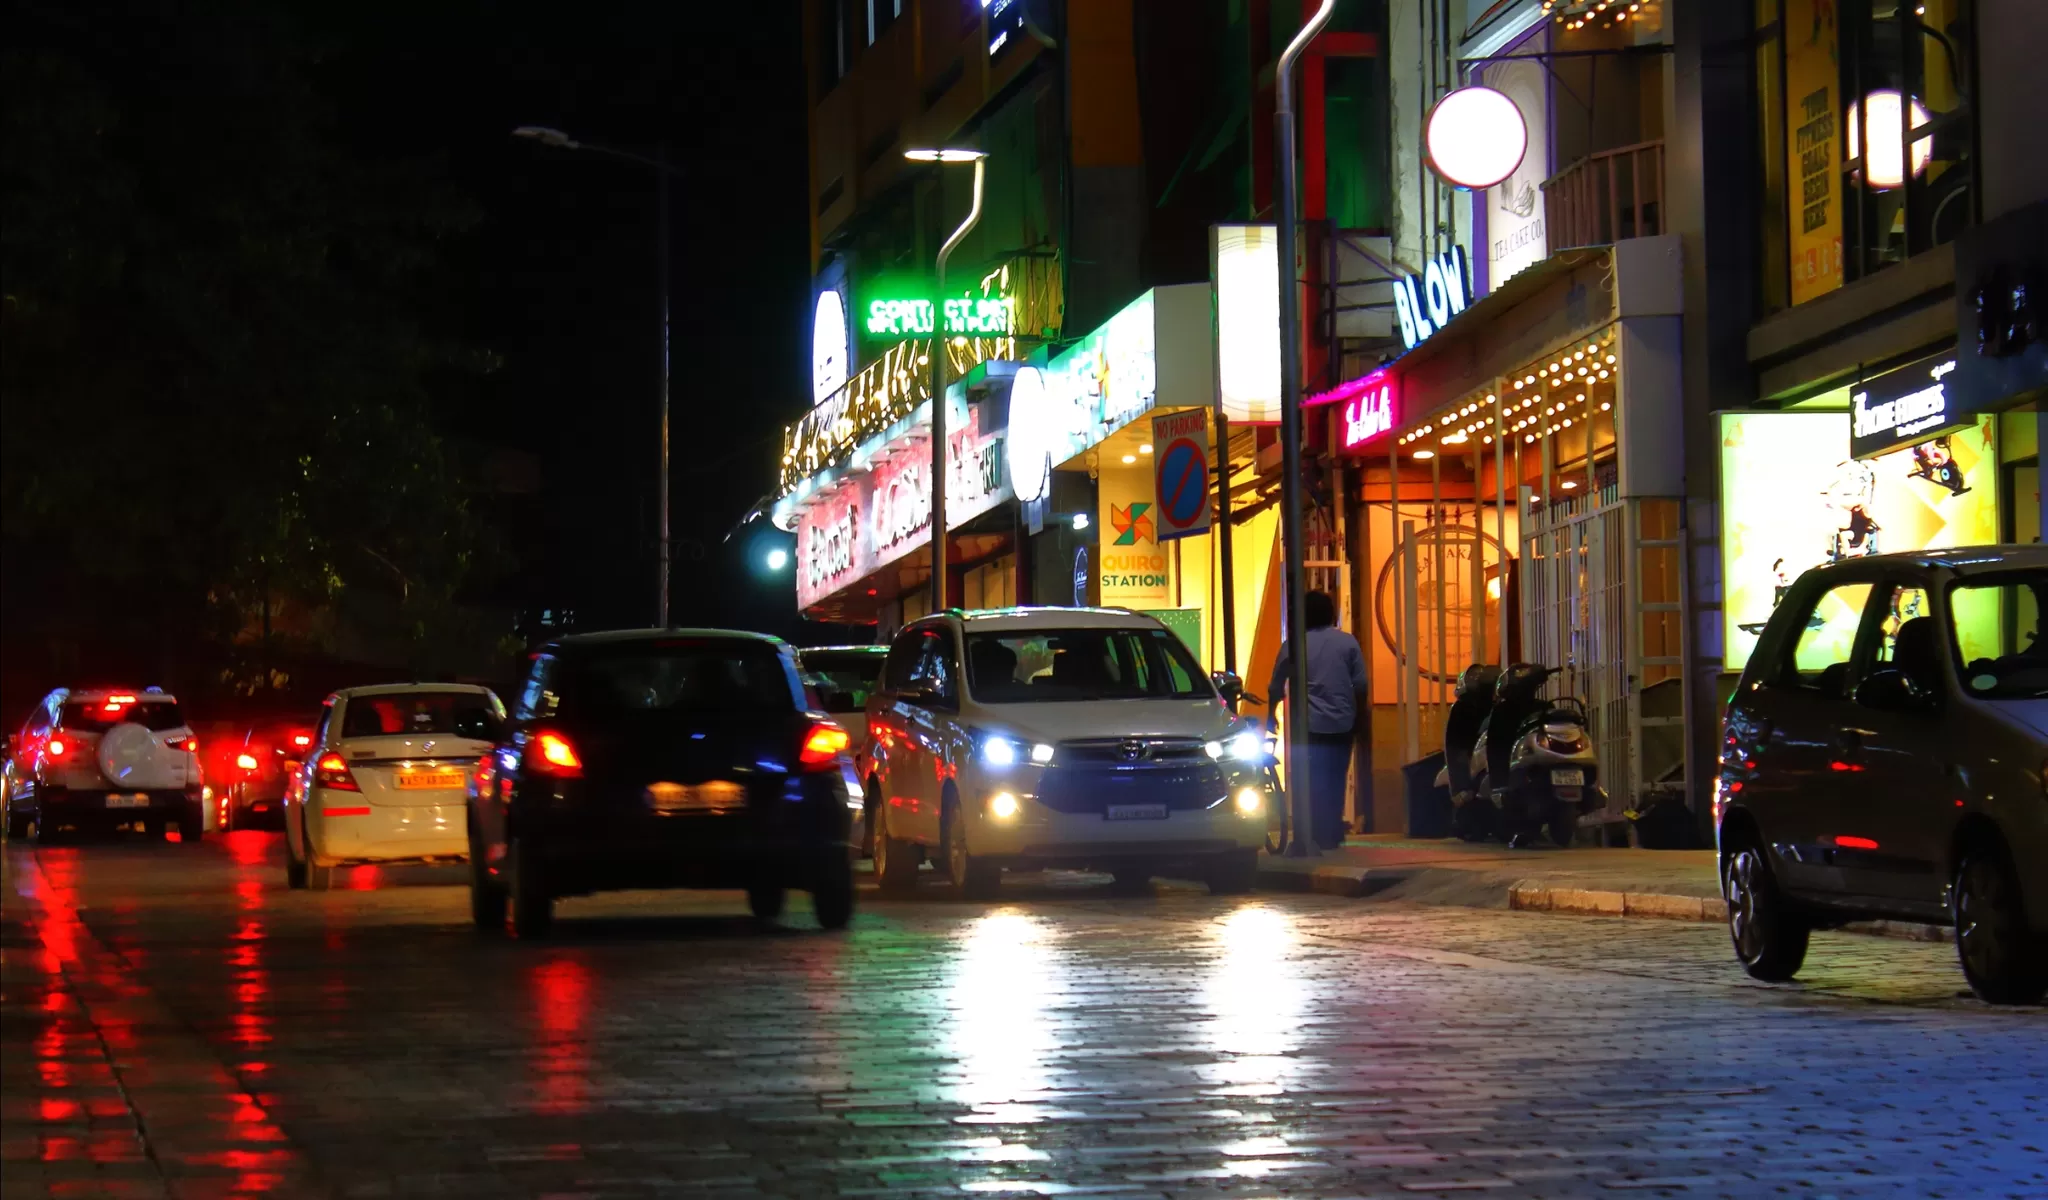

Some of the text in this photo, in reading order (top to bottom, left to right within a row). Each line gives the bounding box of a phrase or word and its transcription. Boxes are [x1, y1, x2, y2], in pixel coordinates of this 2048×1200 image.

[1494, 239, 1509, 262] TEA
[1510, 225, 1530, 252] CAKE
[1392, 244, 1467, 349] BLOW
[1156, 412, 1205, 440] NO PARKING
[1101, 555, 1164, 572] QUIRO
[1101, 575, 1166, 587] STATION
